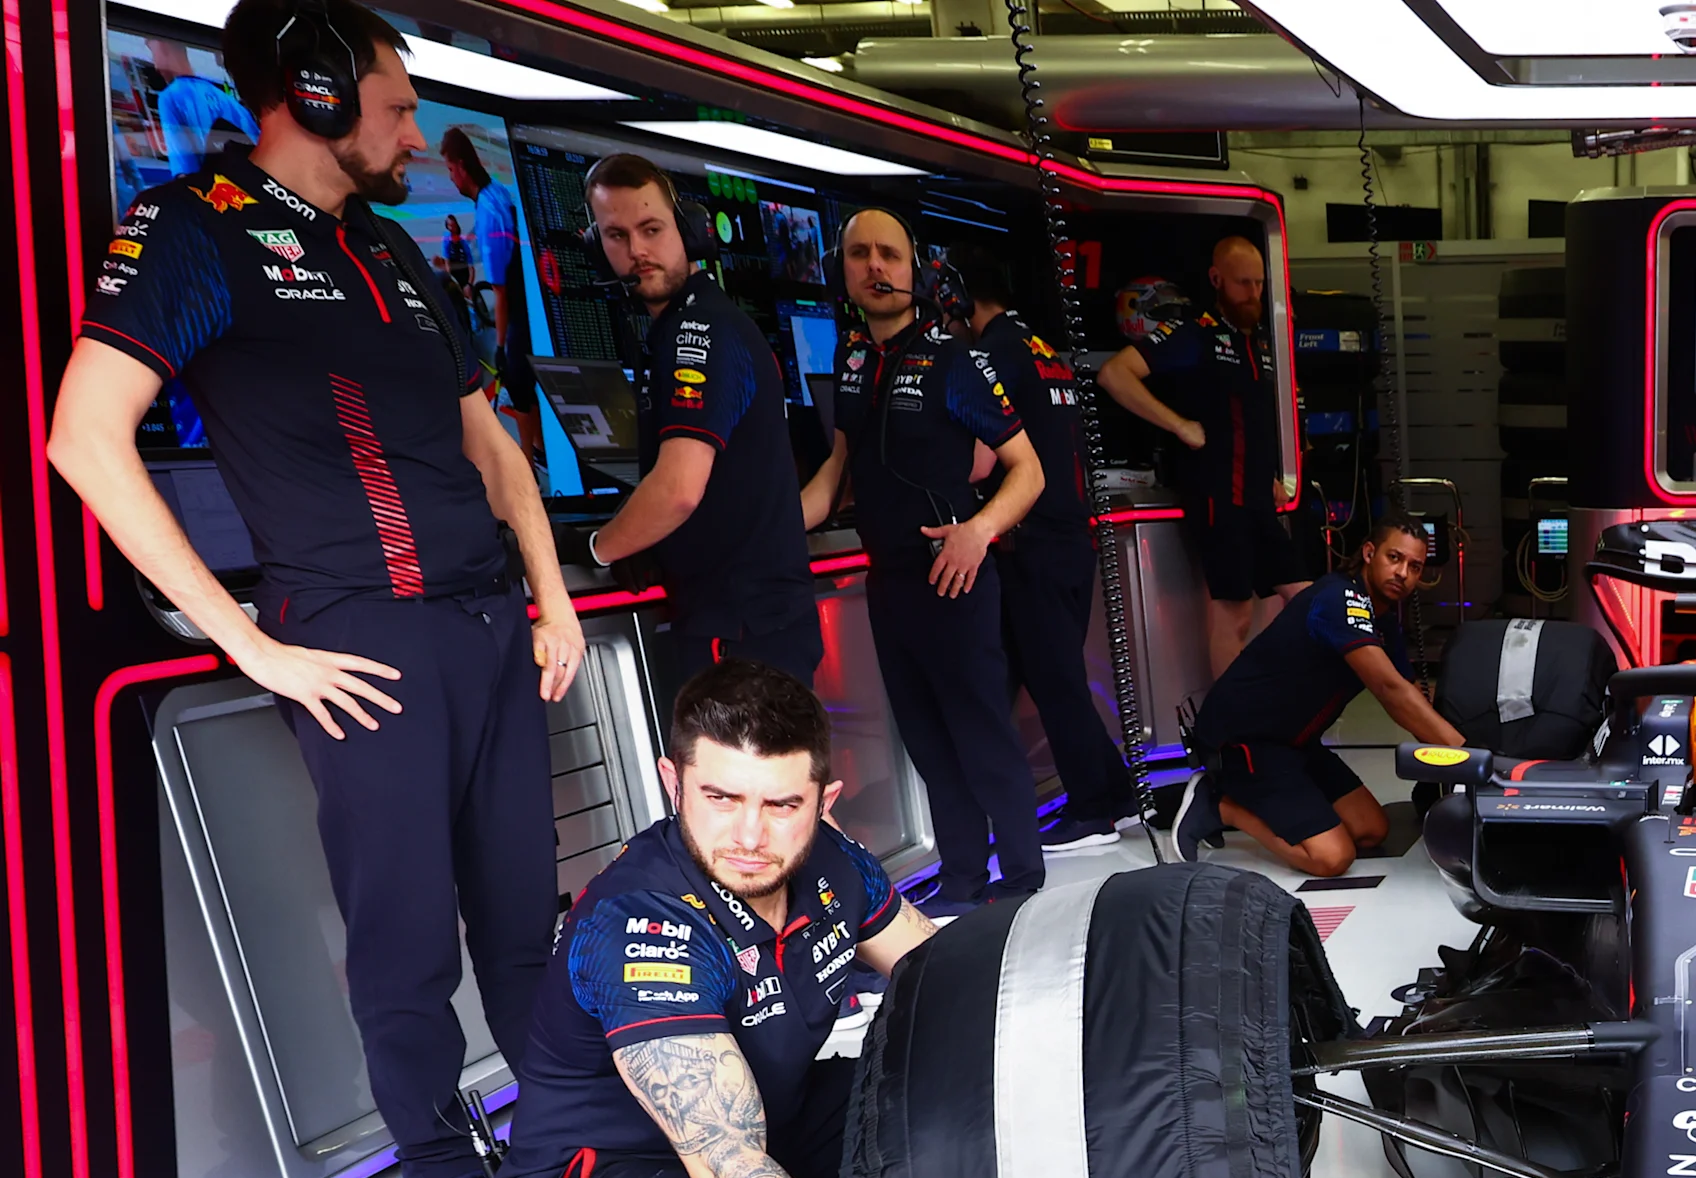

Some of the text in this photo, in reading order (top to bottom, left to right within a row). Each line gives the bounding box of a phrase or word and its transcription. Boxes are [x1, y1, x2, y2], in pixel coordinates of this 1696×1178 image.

[262, 178, 316, 221] zoom
[256, 231, 294, 245] TAG
[274, 288, 346, 301] ORACLE
[676, 332, 712, 349] citrix
[1298, 341, 1319, 349] Left
[1642, 755, 1685, 766] inter.mx
[1522, 804, 1606, 812] Walmart
[625, 917, 692, 941] Mobil
[812, 921, 851, 963] BYBIT
[624, 942, 690, 960] Claro
[815, 943, 858, 983] HOND
[630, 967, 685, 979] PIRELLI
[673, 989, 700, 1003] App
